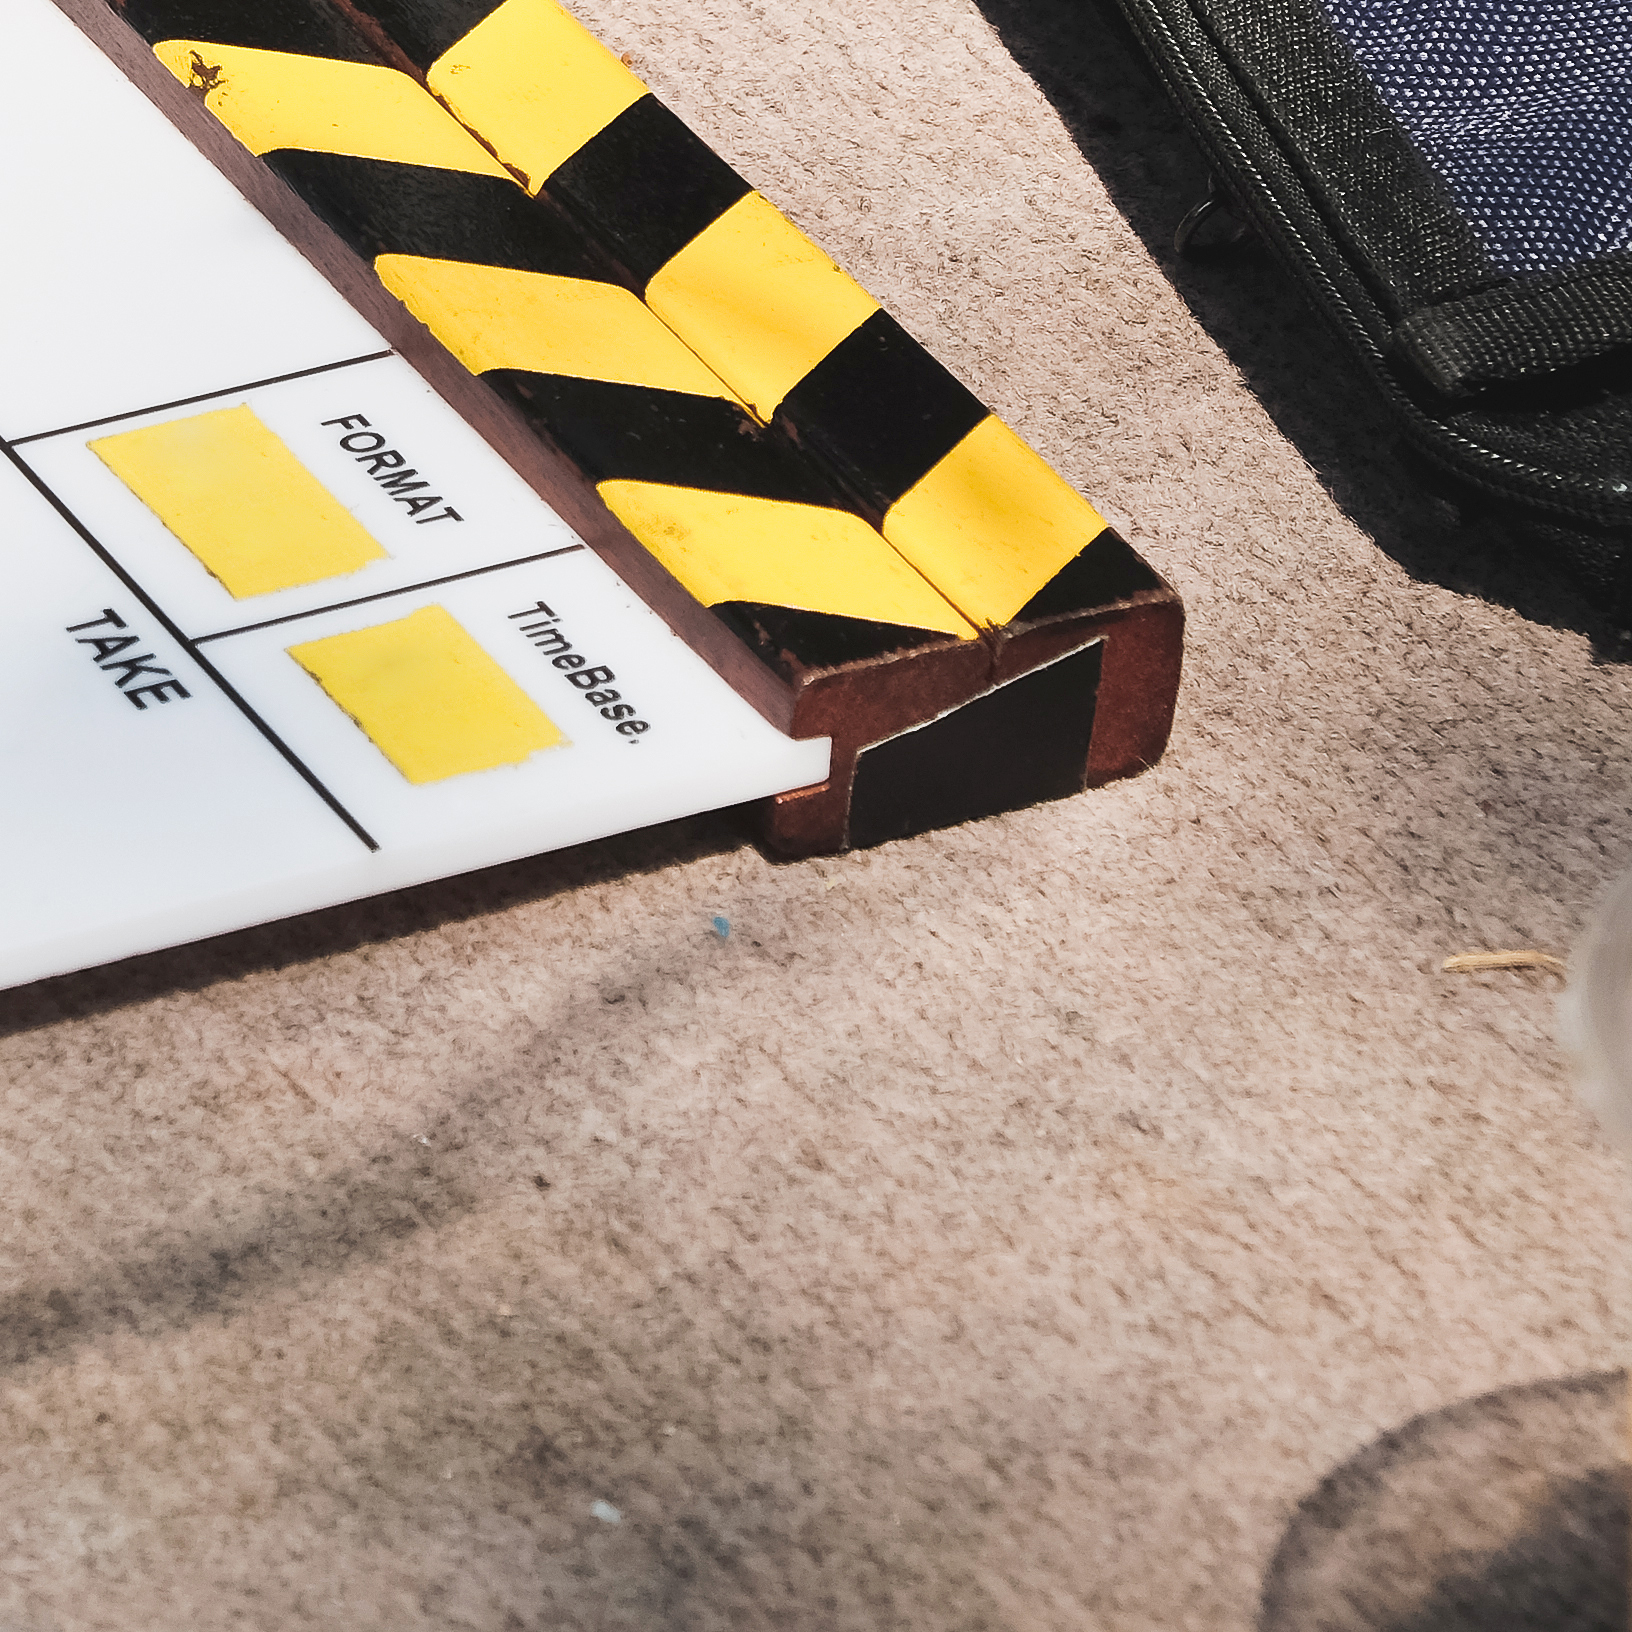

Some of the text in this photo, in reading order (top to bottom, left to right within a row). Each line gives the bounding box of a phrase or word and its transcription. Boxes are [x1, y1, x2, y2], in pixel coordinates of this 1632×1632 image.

[319, 412, 465, 525] FORMAT
[64, 607, 190, 712] TAKE
[506, 599, 653, 744] TimeBase.
